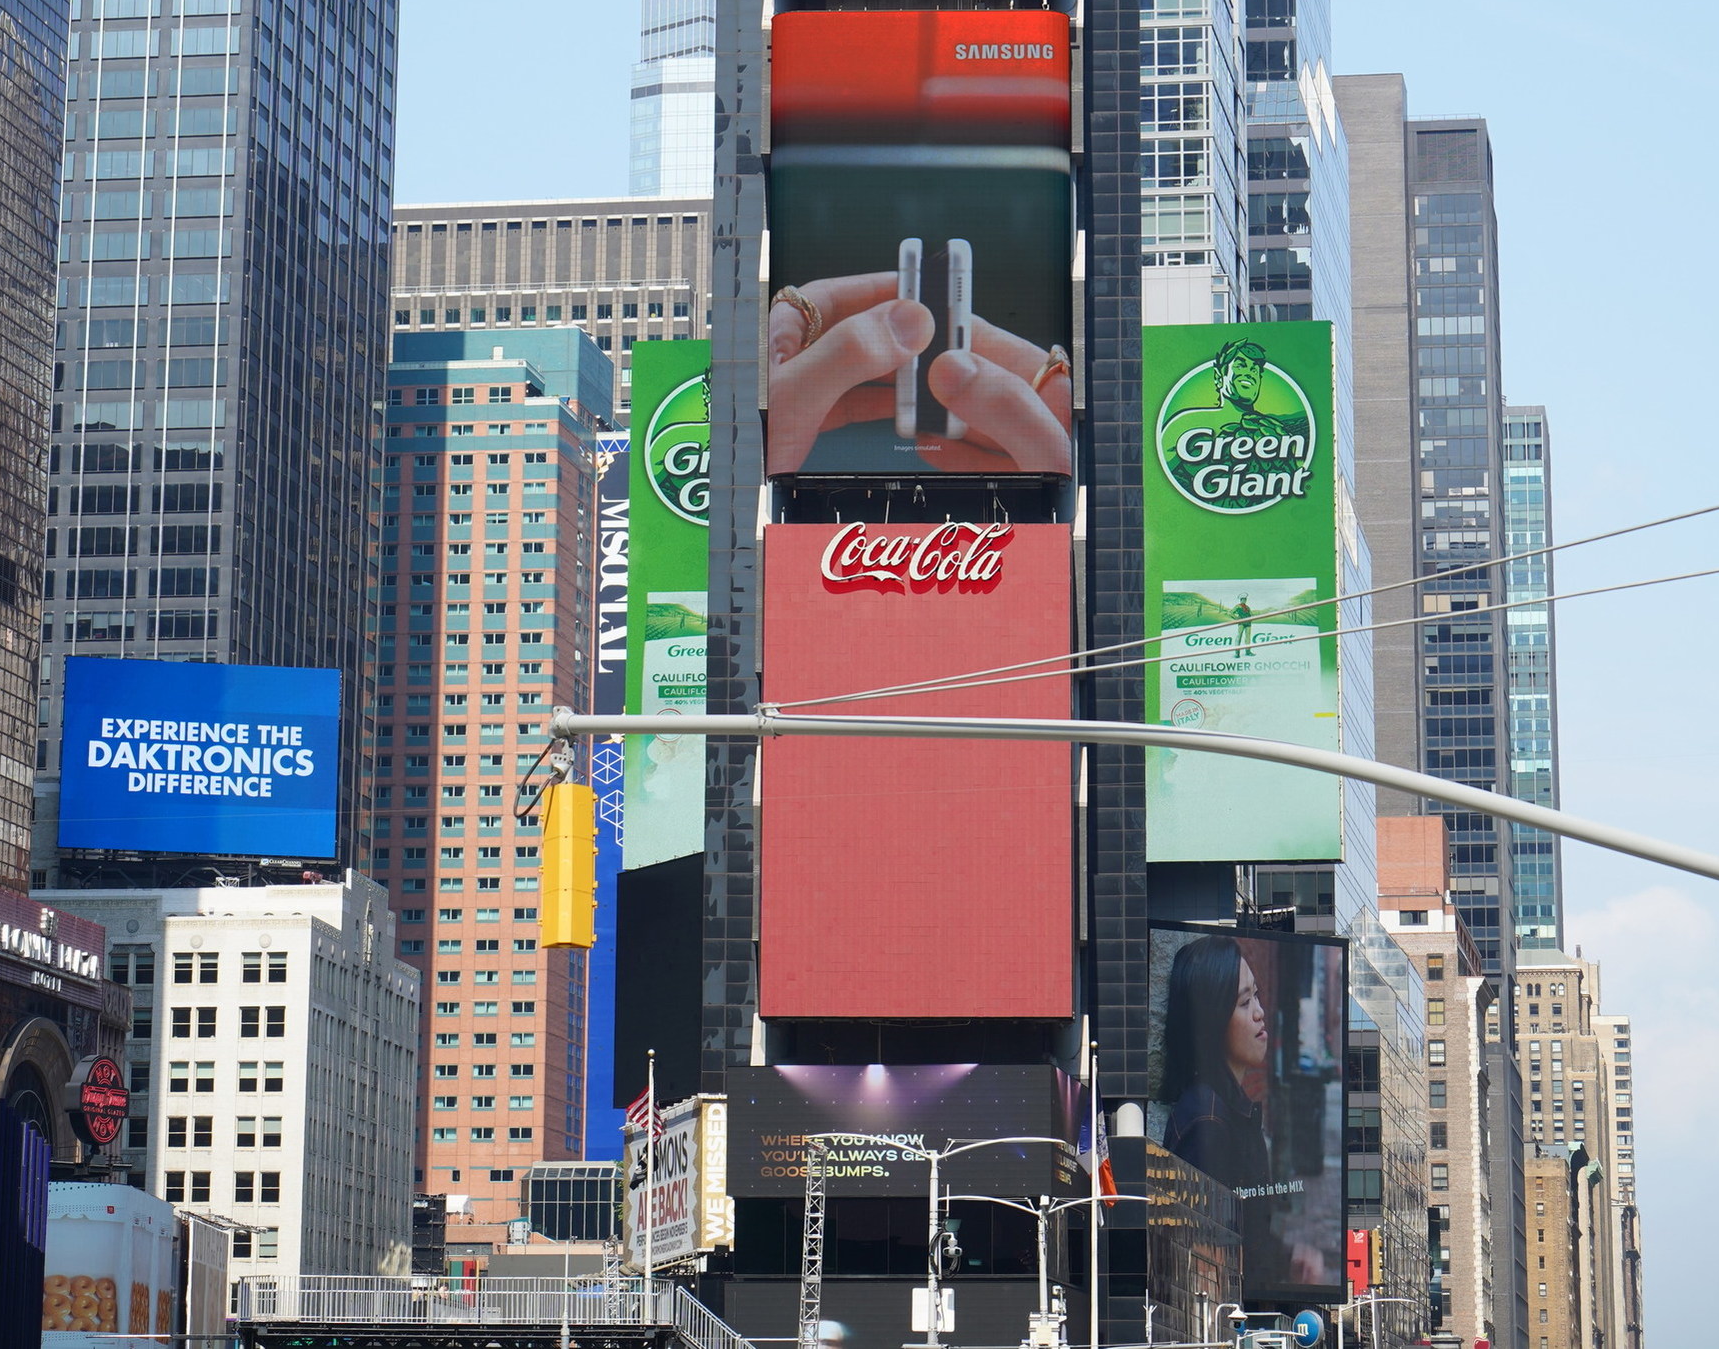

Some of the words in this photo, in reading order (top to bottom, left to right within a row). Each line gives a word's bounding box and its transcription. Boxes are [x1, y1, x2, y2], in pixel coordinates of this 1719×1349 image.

[955, 43, 1054, 60] SAMSUNG
[1176, 428, 1305, 462] Green
[1193, 463, 1312, 499] Giant
[820, 521, 1014, 584] Coca-Cola
[1185, 633, 1232, 647] Green
[667, 644, 707, 657] Gree
[1170, 662, 1251, 672] CAULIFLOWER
[1254, 661, 1310, 671] GNOCCHI
[1182, 677, 1248, 686] CAULIFLOWER
[1177, 713, 1200, 726] ITALY
[101, 718, 249, 744] EXPERIENCE
[257, 724, 302, 746] THE
[88, 740, 314, 777] DAKTRONICS
[128, 772, 272, 797] DIFFERENCE
[95, 1065, 115, 1082] HOT
[93, 1116, 116, 1137] NOW
[706, 1103, 727, 1193] MISSED
[760, 1134, 824, 1146] WHERE
[830, 1134, 863, 1146] YOU
[870, 1134, 924, 1146] KNOW
[826, 1150, 898, 1162] ALWAYS
[901, 1150, 930, 1162] GE
[760, 1165, 890, 1177] GOOSEBUMPS.
[1257, 1184, 1265, 1196] is
[1266, 1183, 1274, 1196] in
[1275, 1182, 1288, 1194] the
[1288, 1180, 1304, 1193] MIX
[659, 1178, 688, 1226] BACK!
[706, 1198, 724, 1241] WE
